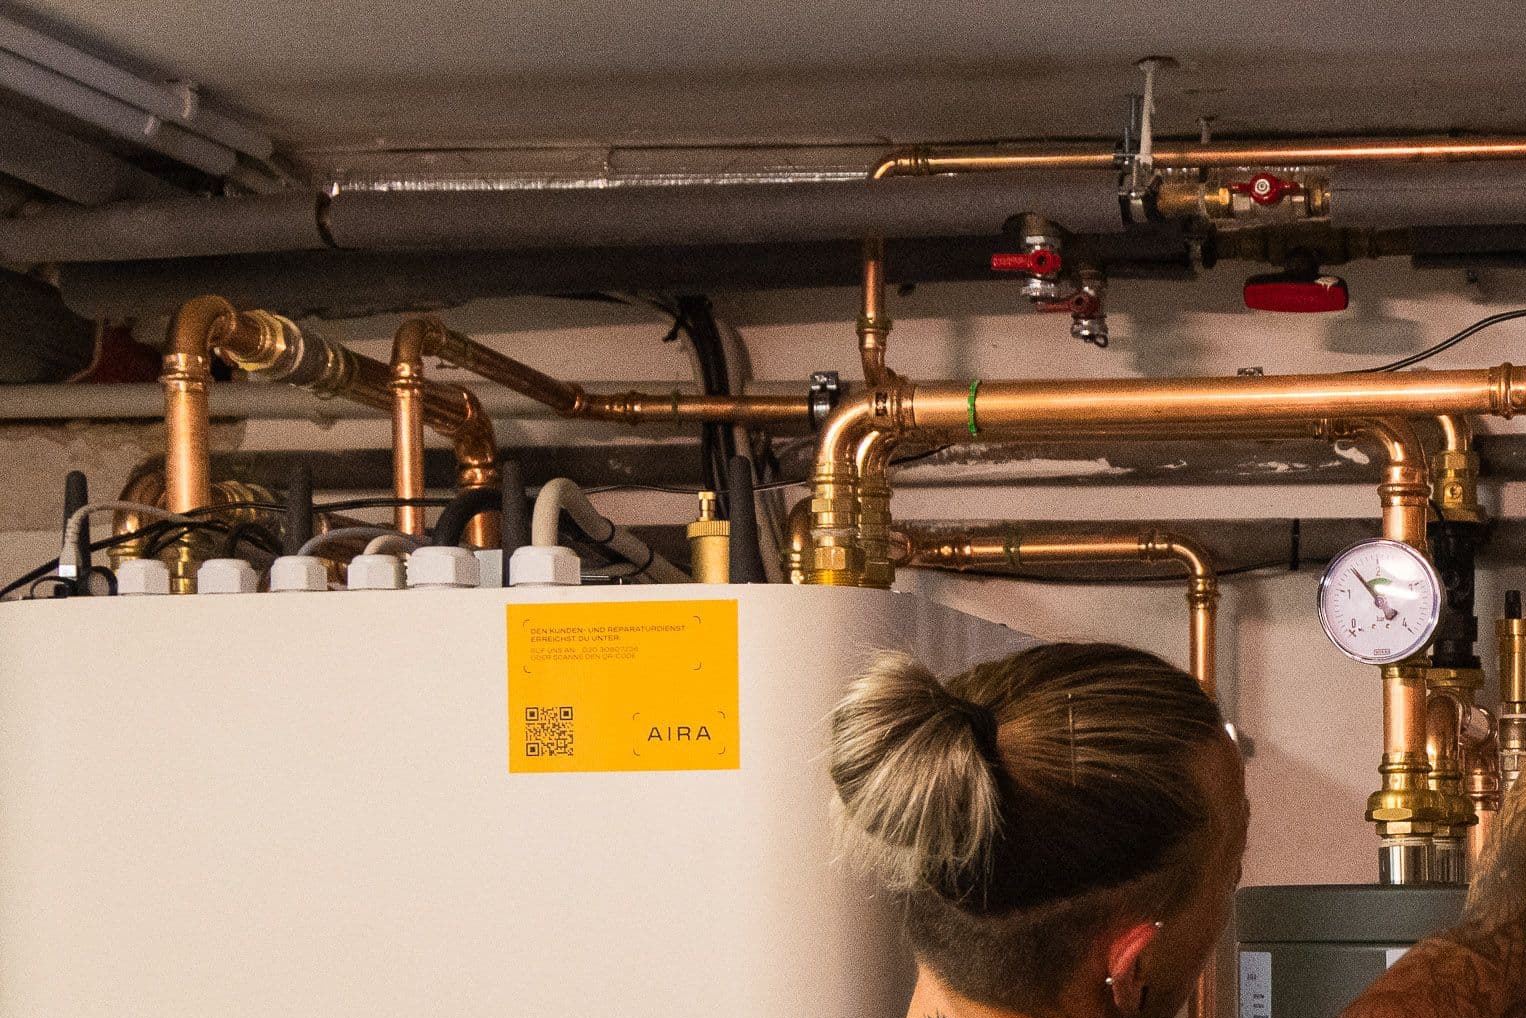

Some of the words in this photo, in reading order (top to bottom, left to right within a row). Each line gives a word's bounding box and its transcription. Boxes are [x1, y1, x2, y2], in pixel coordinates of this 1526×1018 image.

[1375, 566, 1381, 576] 2
[1346, 589, 1352, 600] 1
[608, 624, 686, 632] REPARATURDIENST
[1351, 618, 1356, 628] 0
[1402, 618, 1408, 628] 4
[647, 726, 711, 742] AIRA
